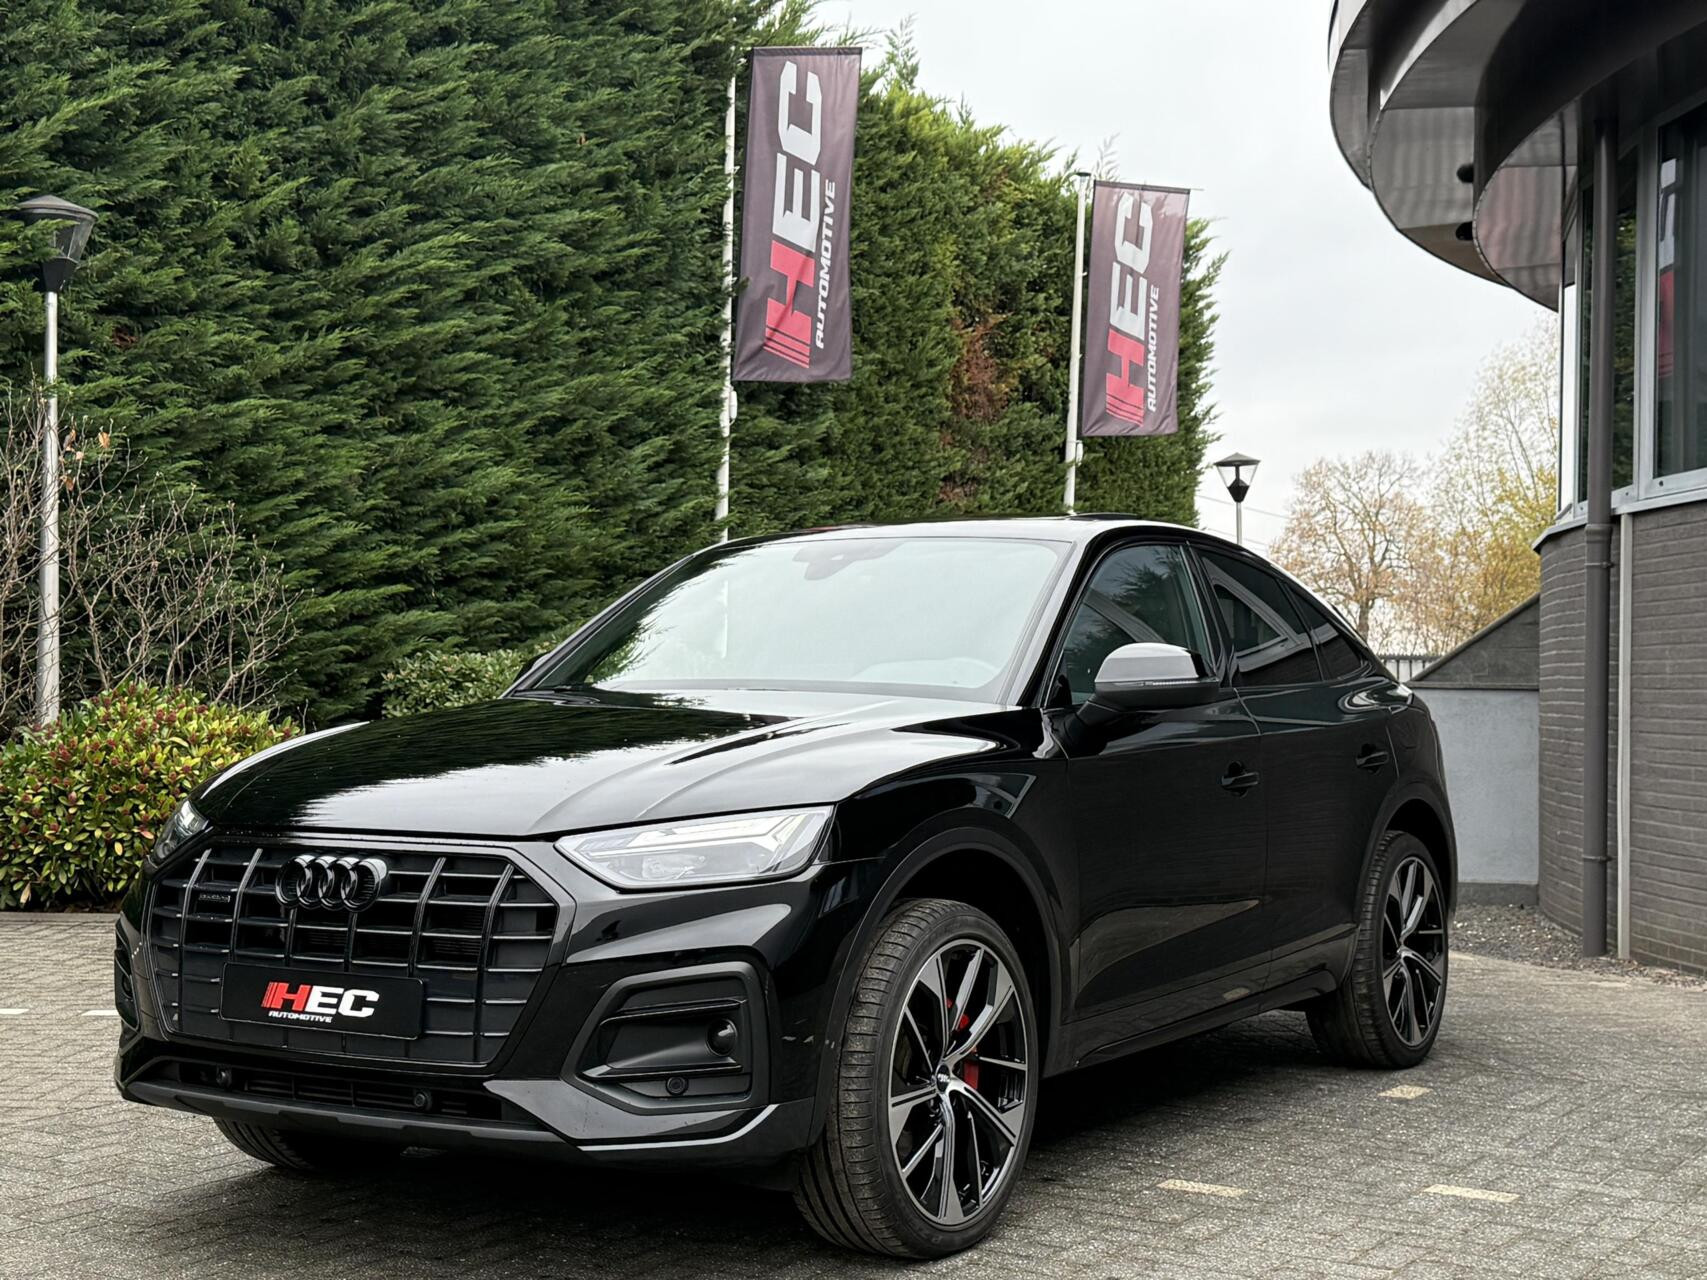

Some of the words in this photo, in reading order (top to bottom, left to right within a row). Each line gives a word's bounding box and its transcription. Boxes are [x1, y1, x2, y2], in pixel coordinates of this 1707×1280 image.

[763, 60, 823, 369] HEC
[815, 178, 836, 350] AUTOMOTIVE
[1105, 191, 1154, 427] HEC
[1147, 284, 1160, 413] AUTOMOTIVE
[261, 981, 380, 1018] HEC
[268, 1010, 333, 1023] AUTOMOTIVE
